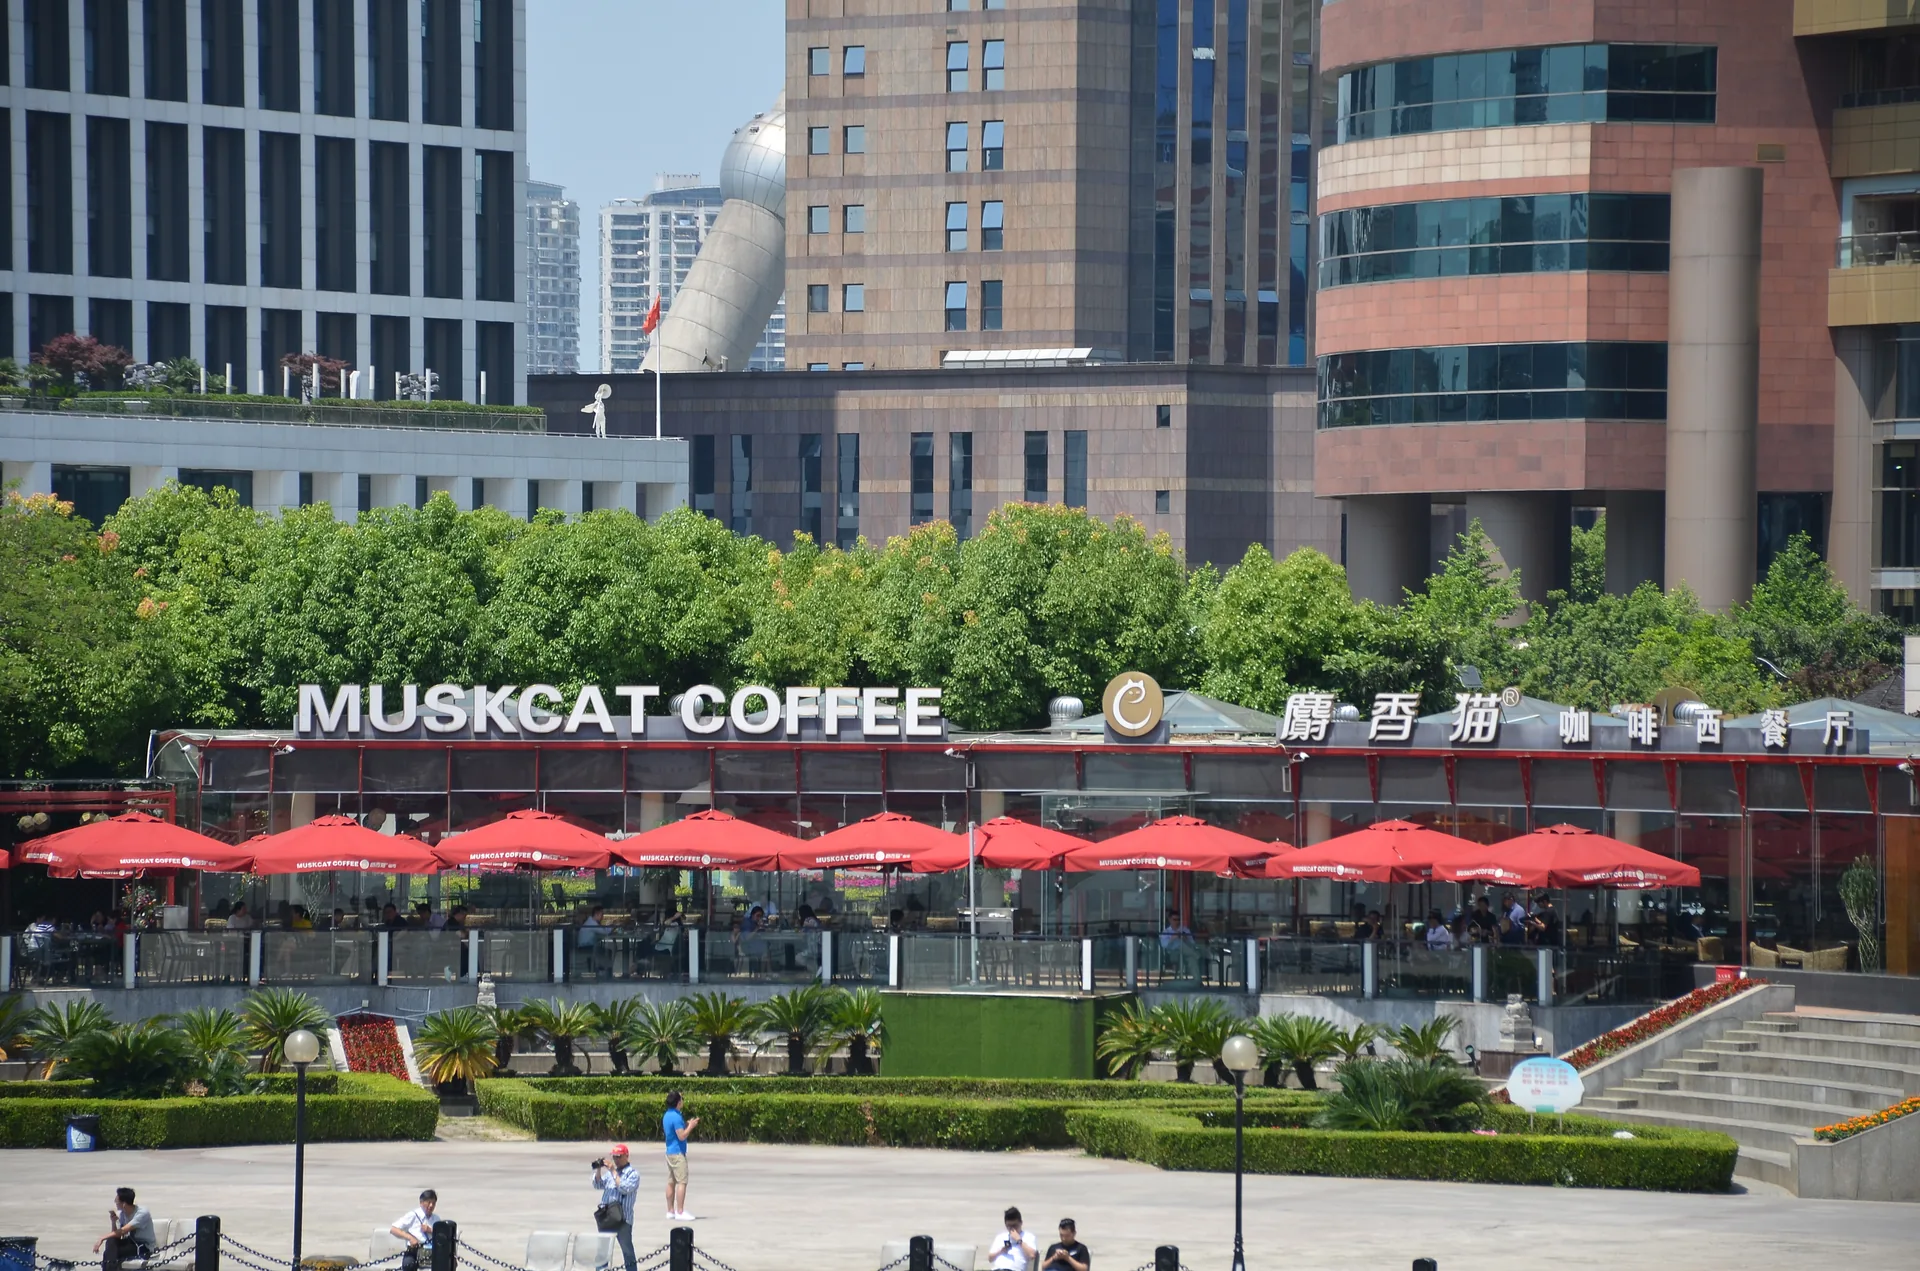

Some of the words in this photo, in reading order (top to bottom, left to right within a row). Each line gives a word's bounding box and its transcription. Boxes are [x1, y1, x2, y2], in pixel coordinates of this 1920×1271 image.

[298, 683, 660, 734] MUSKCAT
[680, 683, 943, 736] COFFEE
[1559, 705, 1851, 748] 咖啡西餐厅
[119, 857, 154, 865] MUSKCAT
[470, 852, 504, 860] MUSKCAT
[816, 855, 849, 864] MUSKCAT
[849, 853, 875, 861] COFFEE
[296, 860, 332, 869] MUSKCAT
